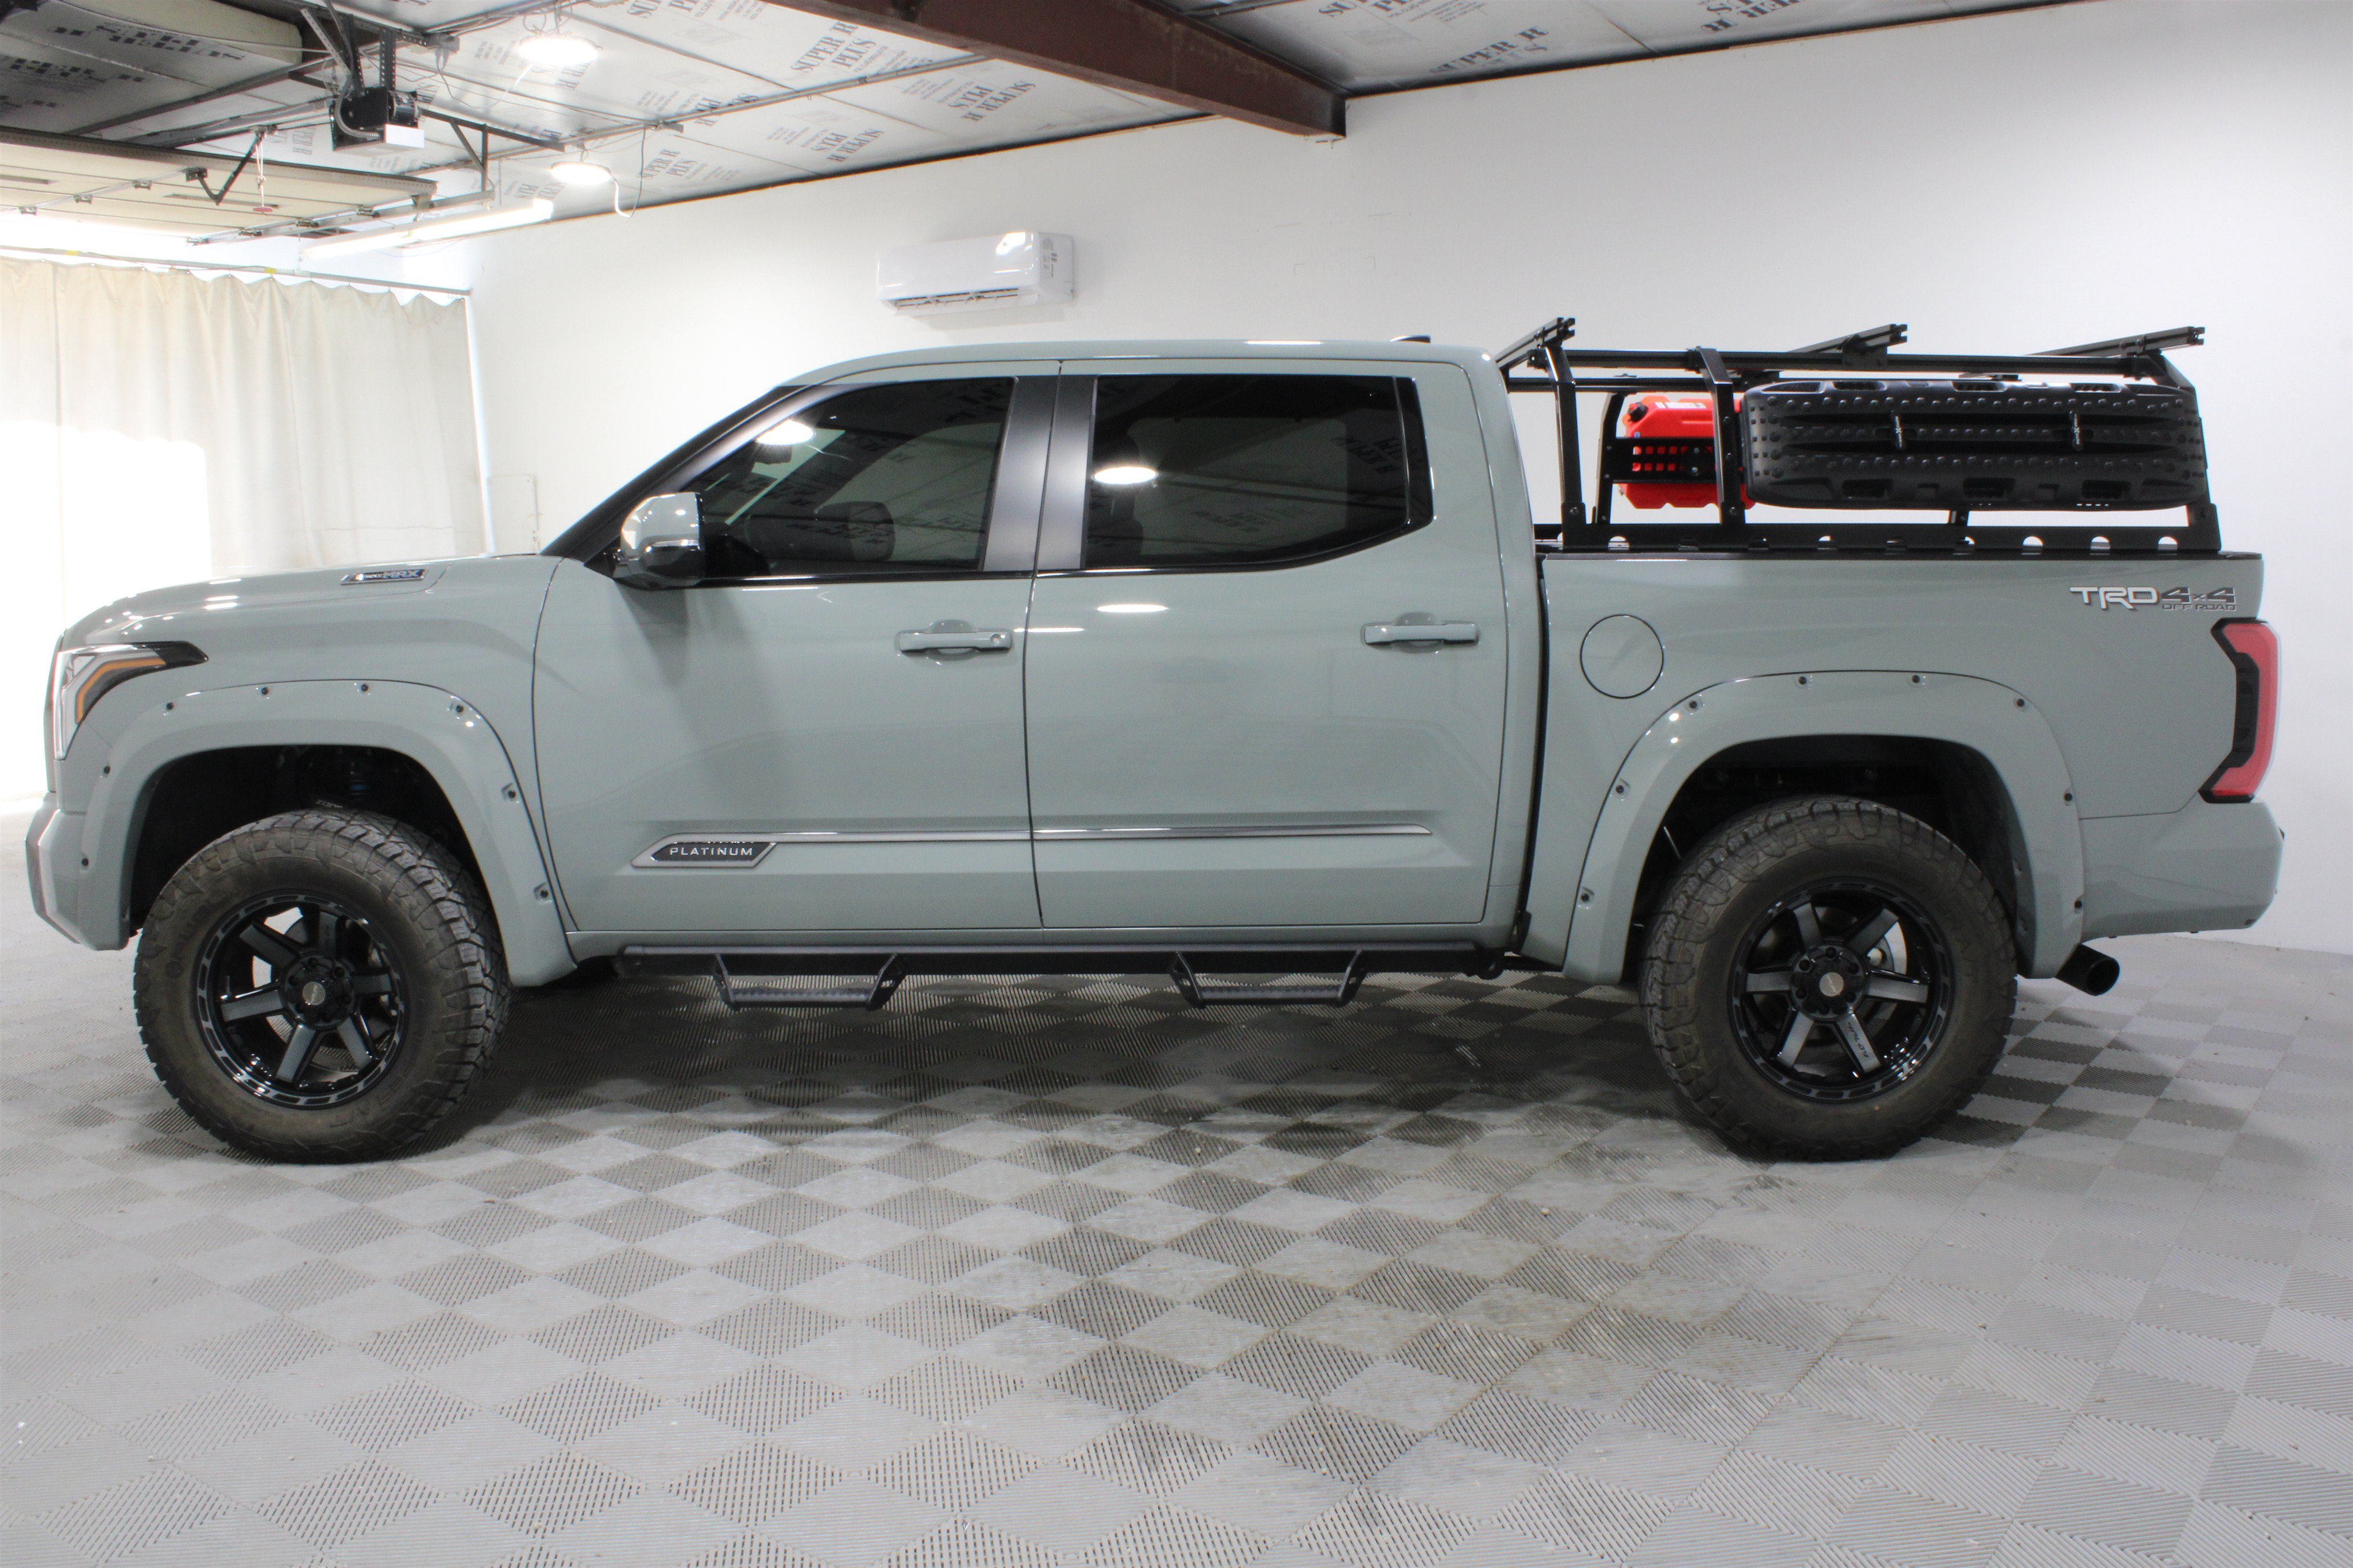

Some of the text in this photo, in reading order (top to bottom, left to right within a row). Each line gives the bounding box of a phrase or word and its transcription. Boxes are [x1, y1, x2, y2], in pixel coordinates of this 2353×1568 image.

[790, 21, 859, 73] SUPER R
[830, 38, 877, 67] PLUS
[948, 85, 994, 110] PLUS
[975, 80, 1036, 111] SUPER
[961, 111, 987, 121] R
[811, 132, 848, 153] PLUS
[836, 129, 885, 154] SUPER
[666, 159, 699, 177] PLUS
[2069, 586, 2236, 610] TRD 4x4
[2195, 604, 2237, 612] ROAD
[669, 847, 754, 856] PLATINUM
